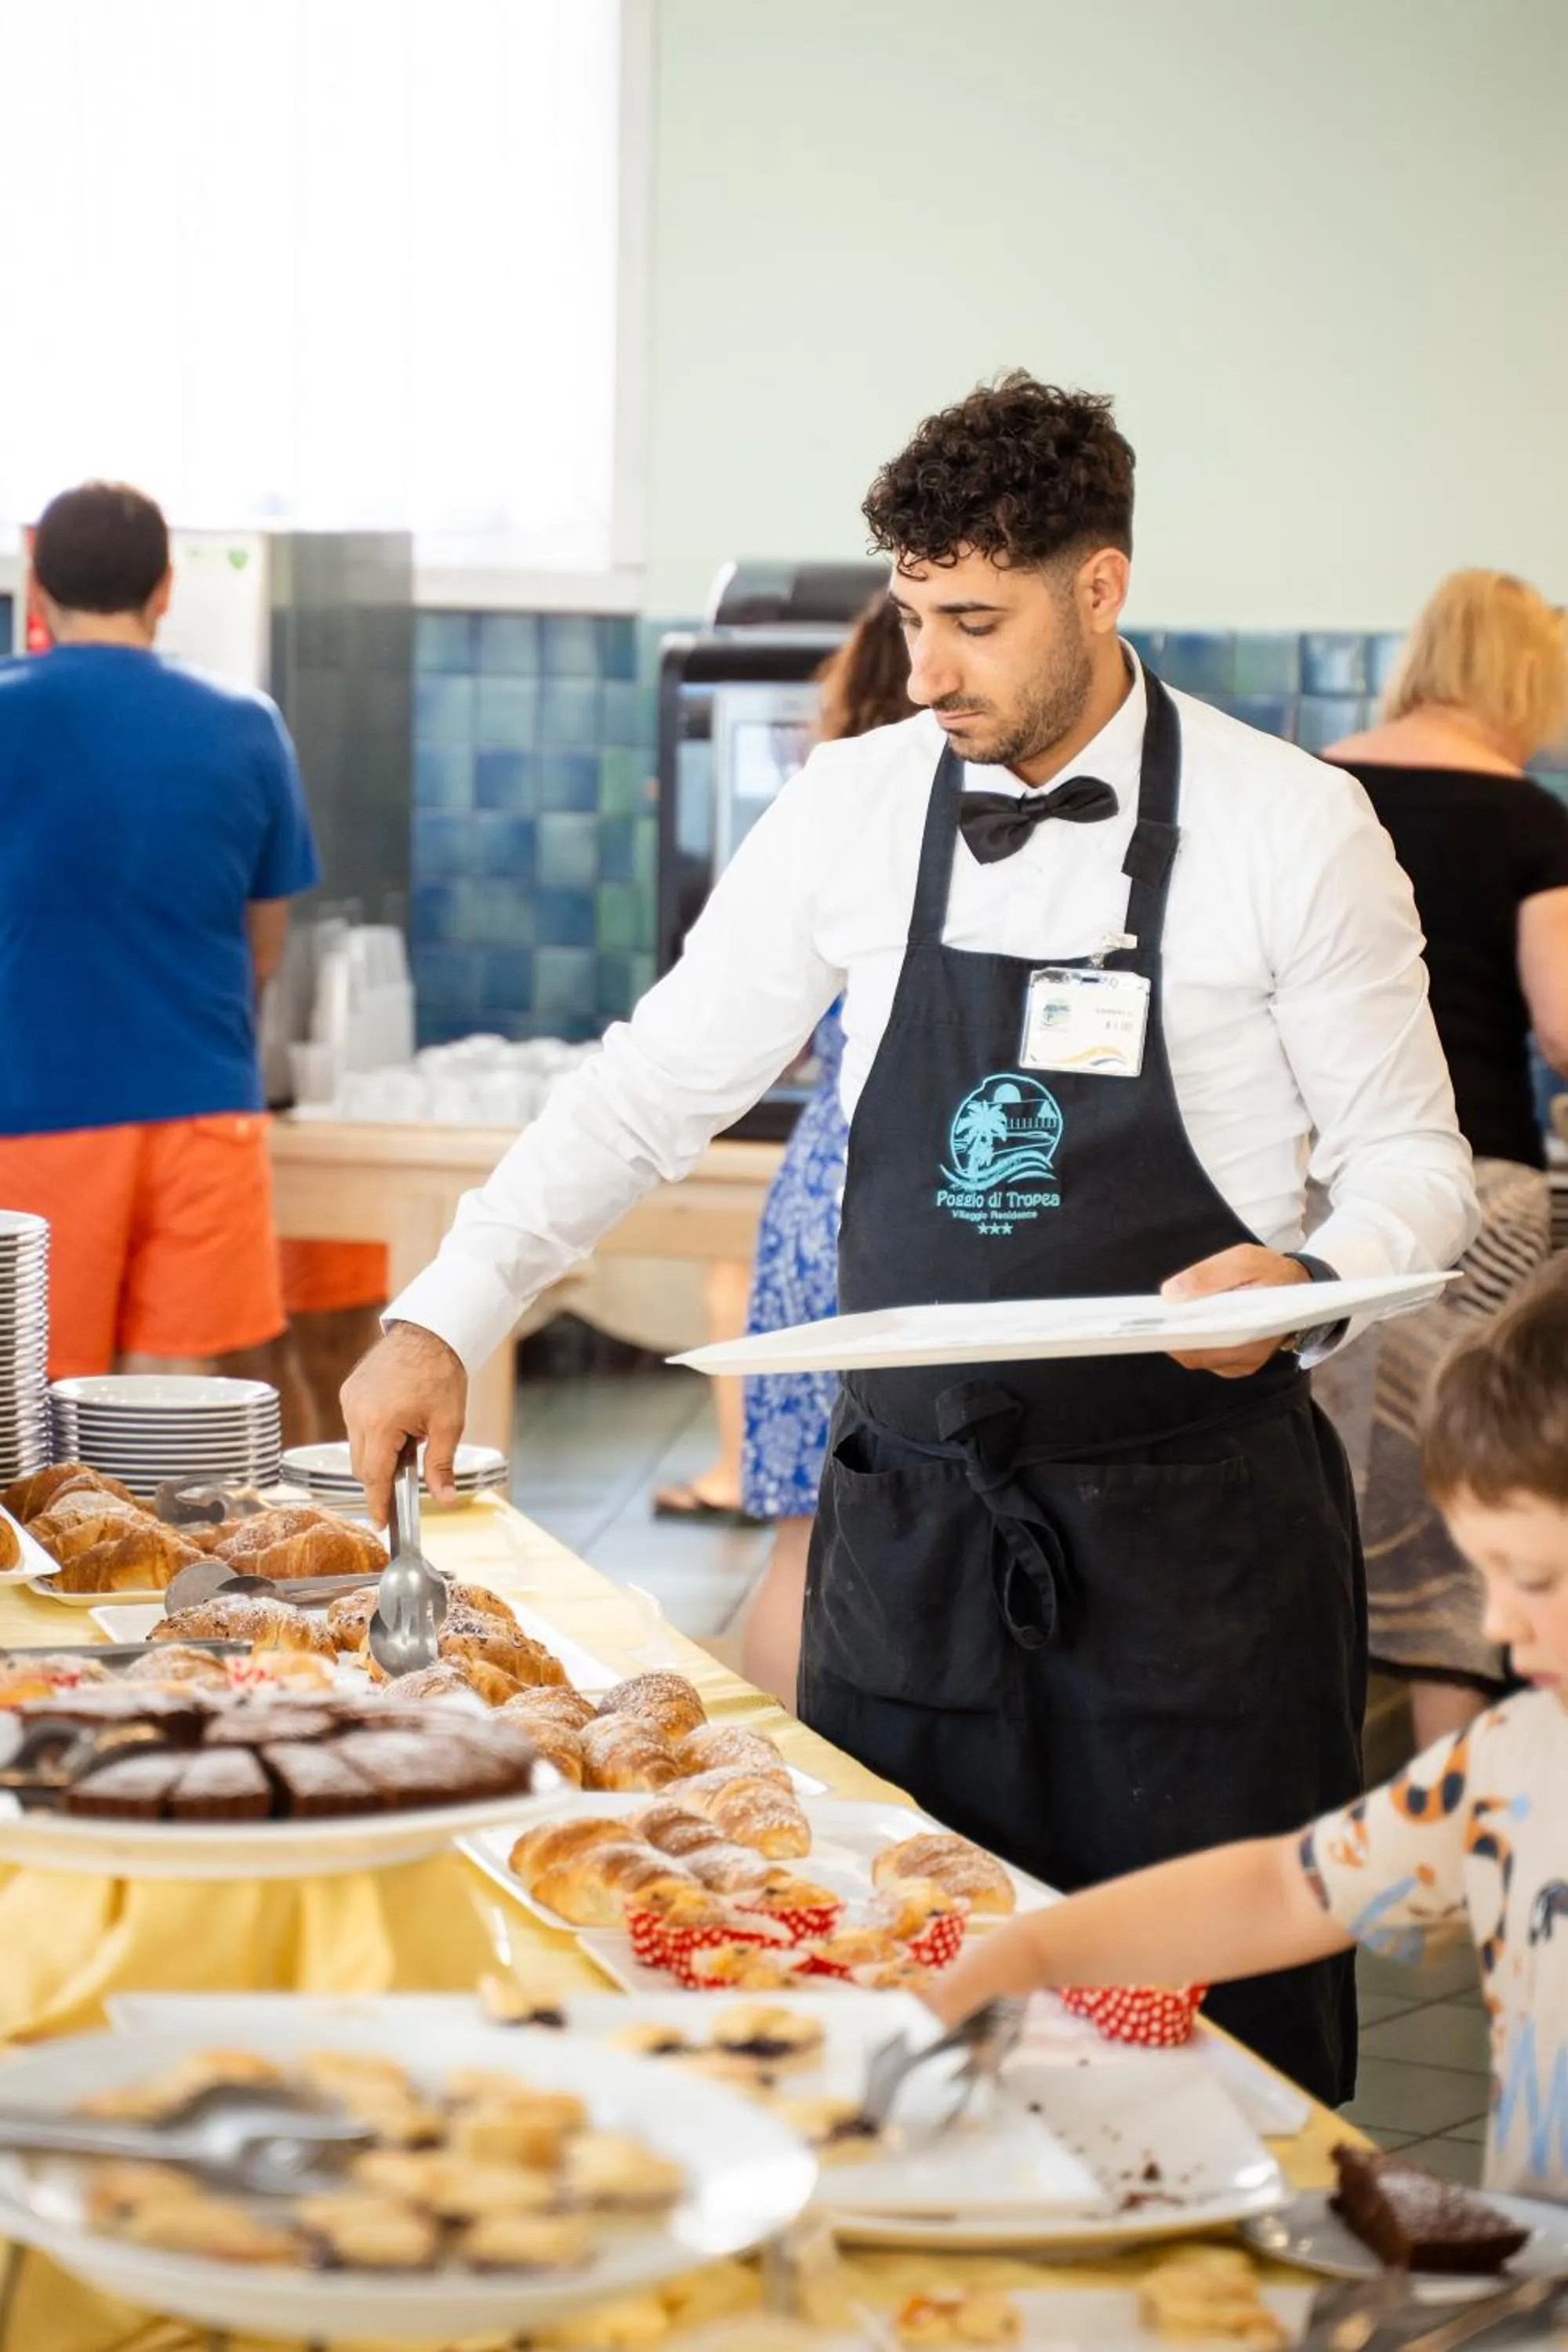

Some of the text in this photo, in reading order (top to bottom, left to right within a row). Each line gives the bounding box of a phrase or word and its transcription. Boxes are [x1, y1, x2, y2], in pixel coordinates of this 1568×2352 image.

[936, 1190, 1061, 1207] Poggio di Tropea
